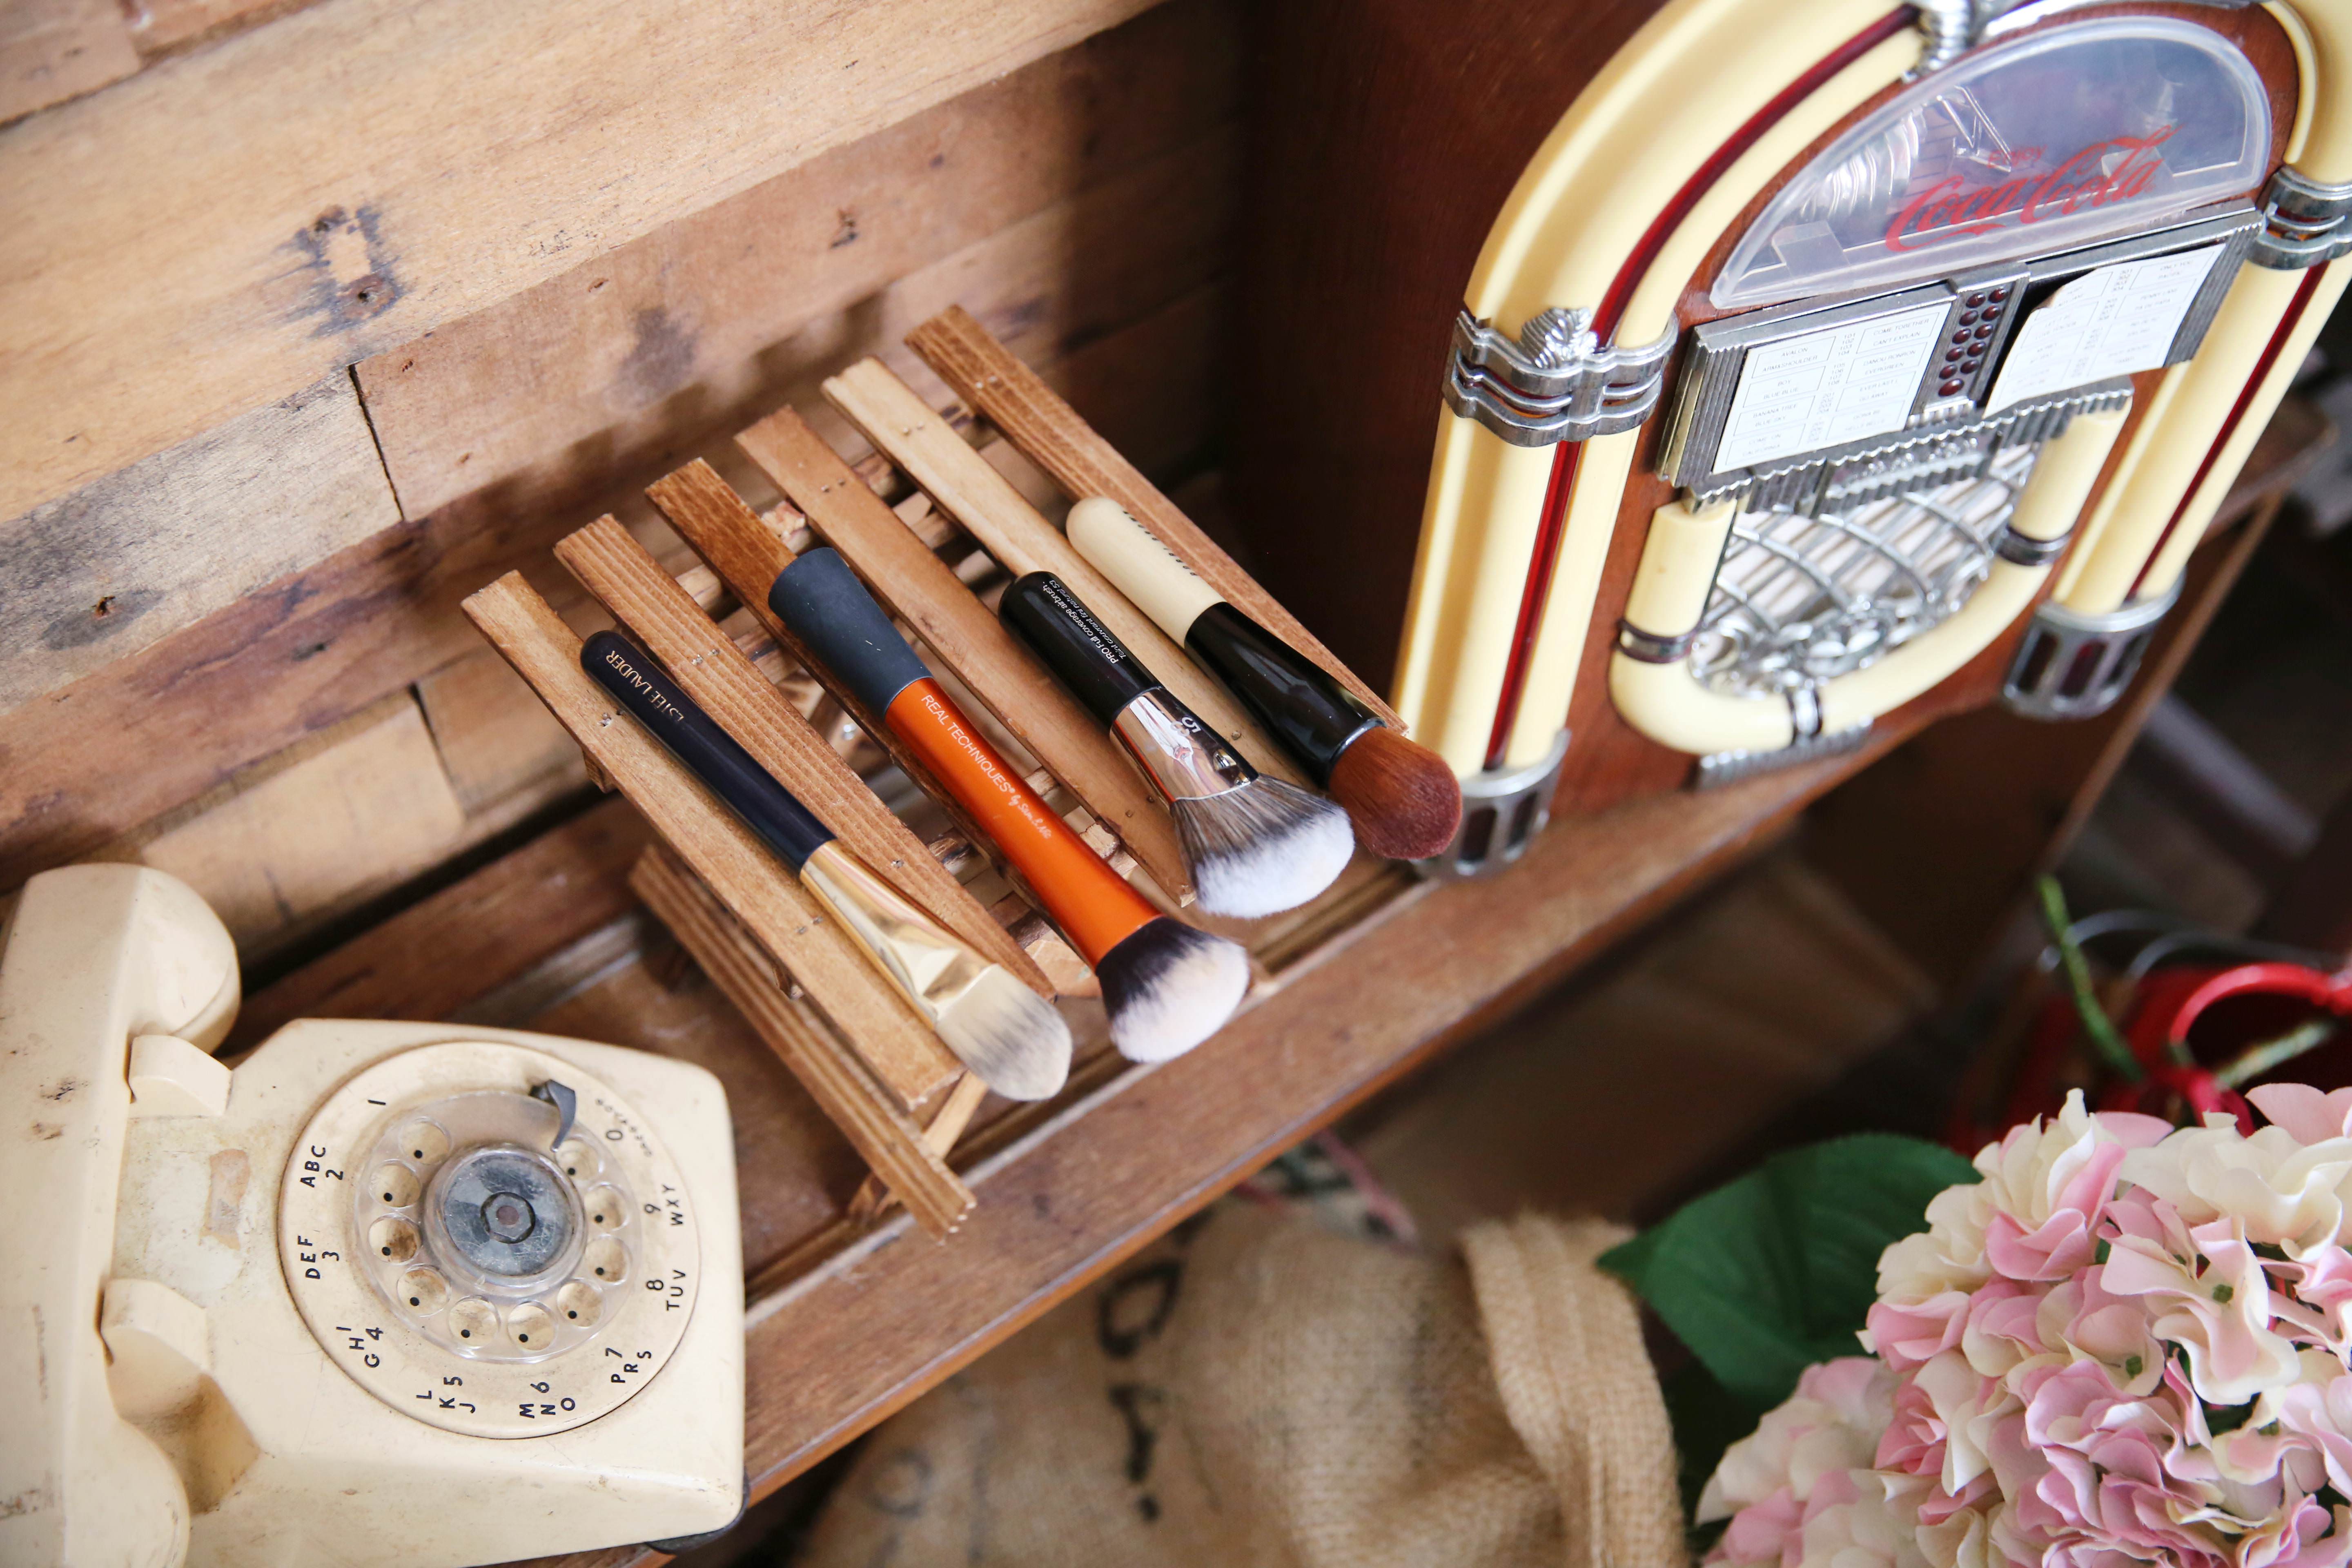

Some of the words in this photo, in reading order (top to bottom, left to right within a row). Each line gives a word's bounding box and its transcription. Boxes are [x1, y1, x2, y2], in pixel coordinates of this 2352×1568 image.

[1886, 124, 2187, 252] Coca-Cola
[1780, 346, 1809, 357] AVALON
[1049, 580, 1060, 588] 53
[1066, 609, 1094, 636] coverage
[1086, 618, 1113, 643] couvrant
[1090, 636, 1102, 648] Full
[1102, 648, 1118, 664] PRO
[606, 650, 653, 695] LAUDER
[921, 695, 949, 726] REAL
[300, 1145, 327, 1188] ABC
[325, 1169, 343, 1180] 2
[645, 1204, 660, 1214] 9
[661, 1183, 686, 1225] WXY
[298, 1235, 321, 1279] DEF
[322, 1251, 339, 1261] 3
[646, 1279, 664, 1291] 8
[666, 1270, 686, 1311] TUV
[365, 1327, 383, 1341] 4
[336, 1327, 380, 1368] GHI
[605, 1348, 622, 1358] 7
[610, 1350, 652, 1383] PRS
[443, 1376, 463, 1386] 5
[531, 1381, 550, 1394] 6
[519, 1397, 575, 1419] MNO
